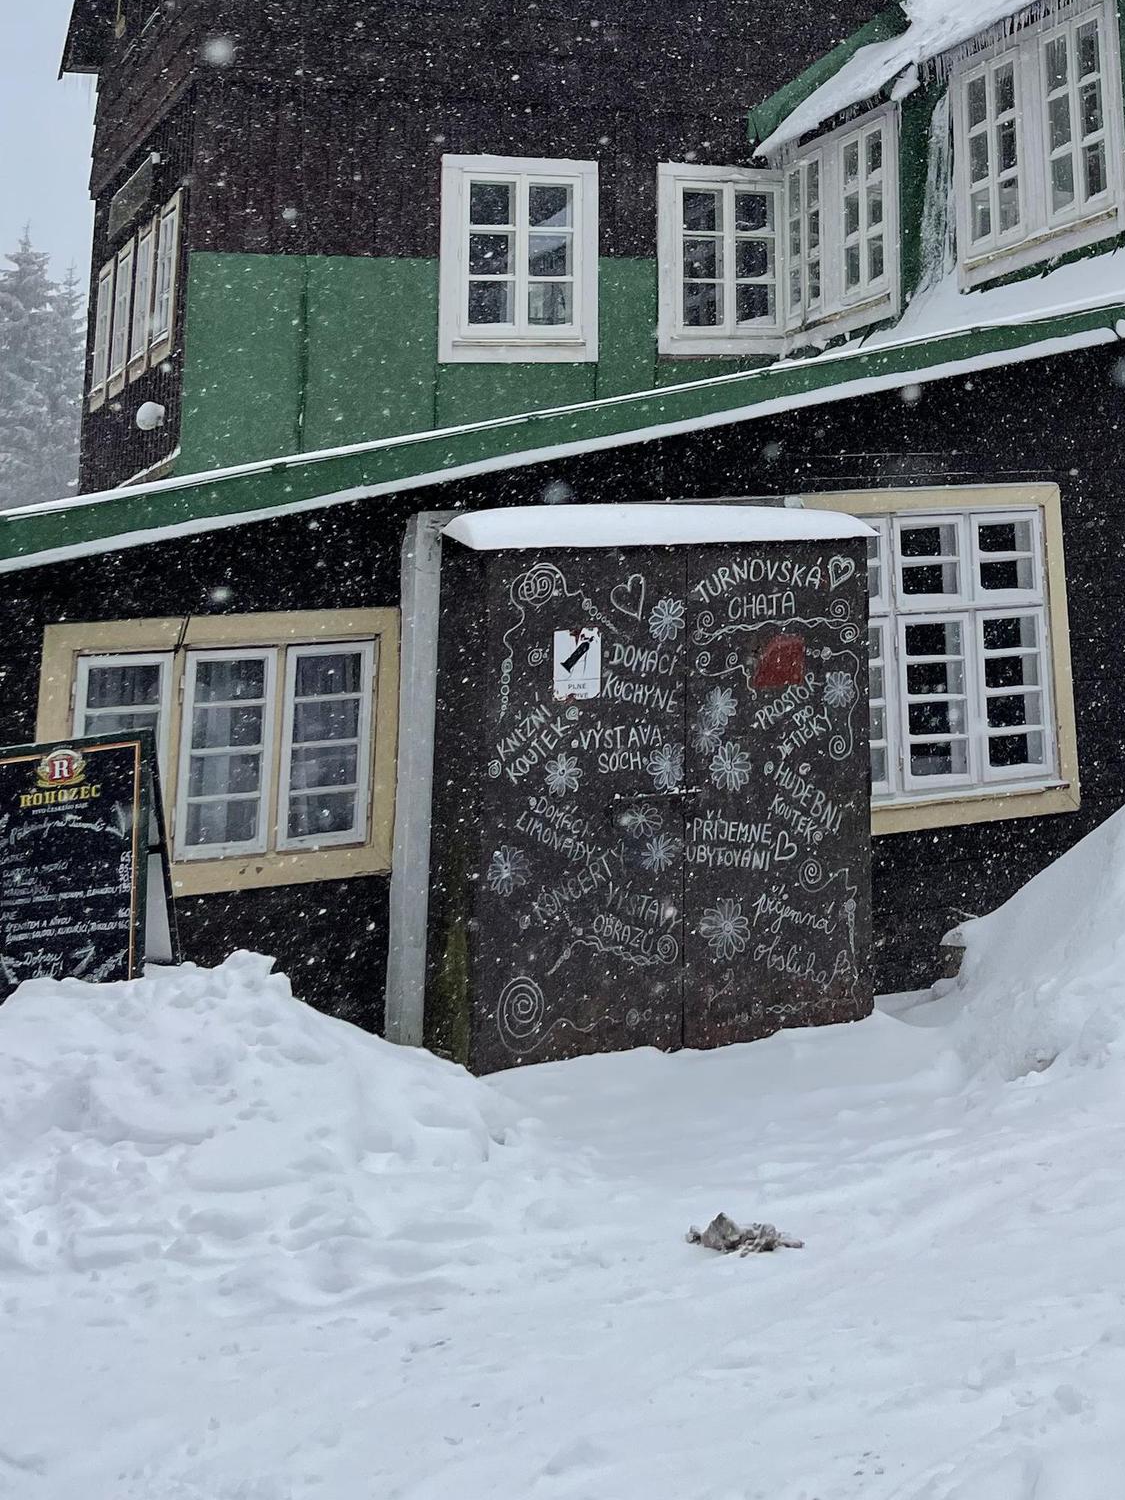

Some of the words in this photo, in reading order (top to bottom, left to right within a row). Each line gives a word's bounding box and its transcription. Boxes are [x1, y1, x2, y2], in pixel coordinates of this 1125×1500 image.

[693, 557, 822, 603] TURNOVSKÁ
[728, 591, 795, 620] CHATA
[609, 643, 681, 676] DOMÁCÍ
[602, 674, 682, 713] KUCHYNĚ
[754, 672, 820, 730] PROSTOR
[496, 692, 552, 762] KNIŽNÍ
[791, 705, 815, 727] PRO
[505, 717, 571, 784] KOUTEK
[580, 721, 662, 750] VÝSTAVA
[52, 759, 70, 780] R
[598, 752, 642, 774] SOCH
[20, 784, 102, 809] ROHOZEC
[693, 809, 772, 844] PŘÍJEMNÉ
[768, 793, 818, 845] KOUTEK
[516, 811, 597, 867] LIMONÁDY
[686, 843, 776, 871] UBYTOVÁNÍ
[531, 842, 627, 920] KONCERTY
[593, 914, 655, 954] OBRAZŮ
